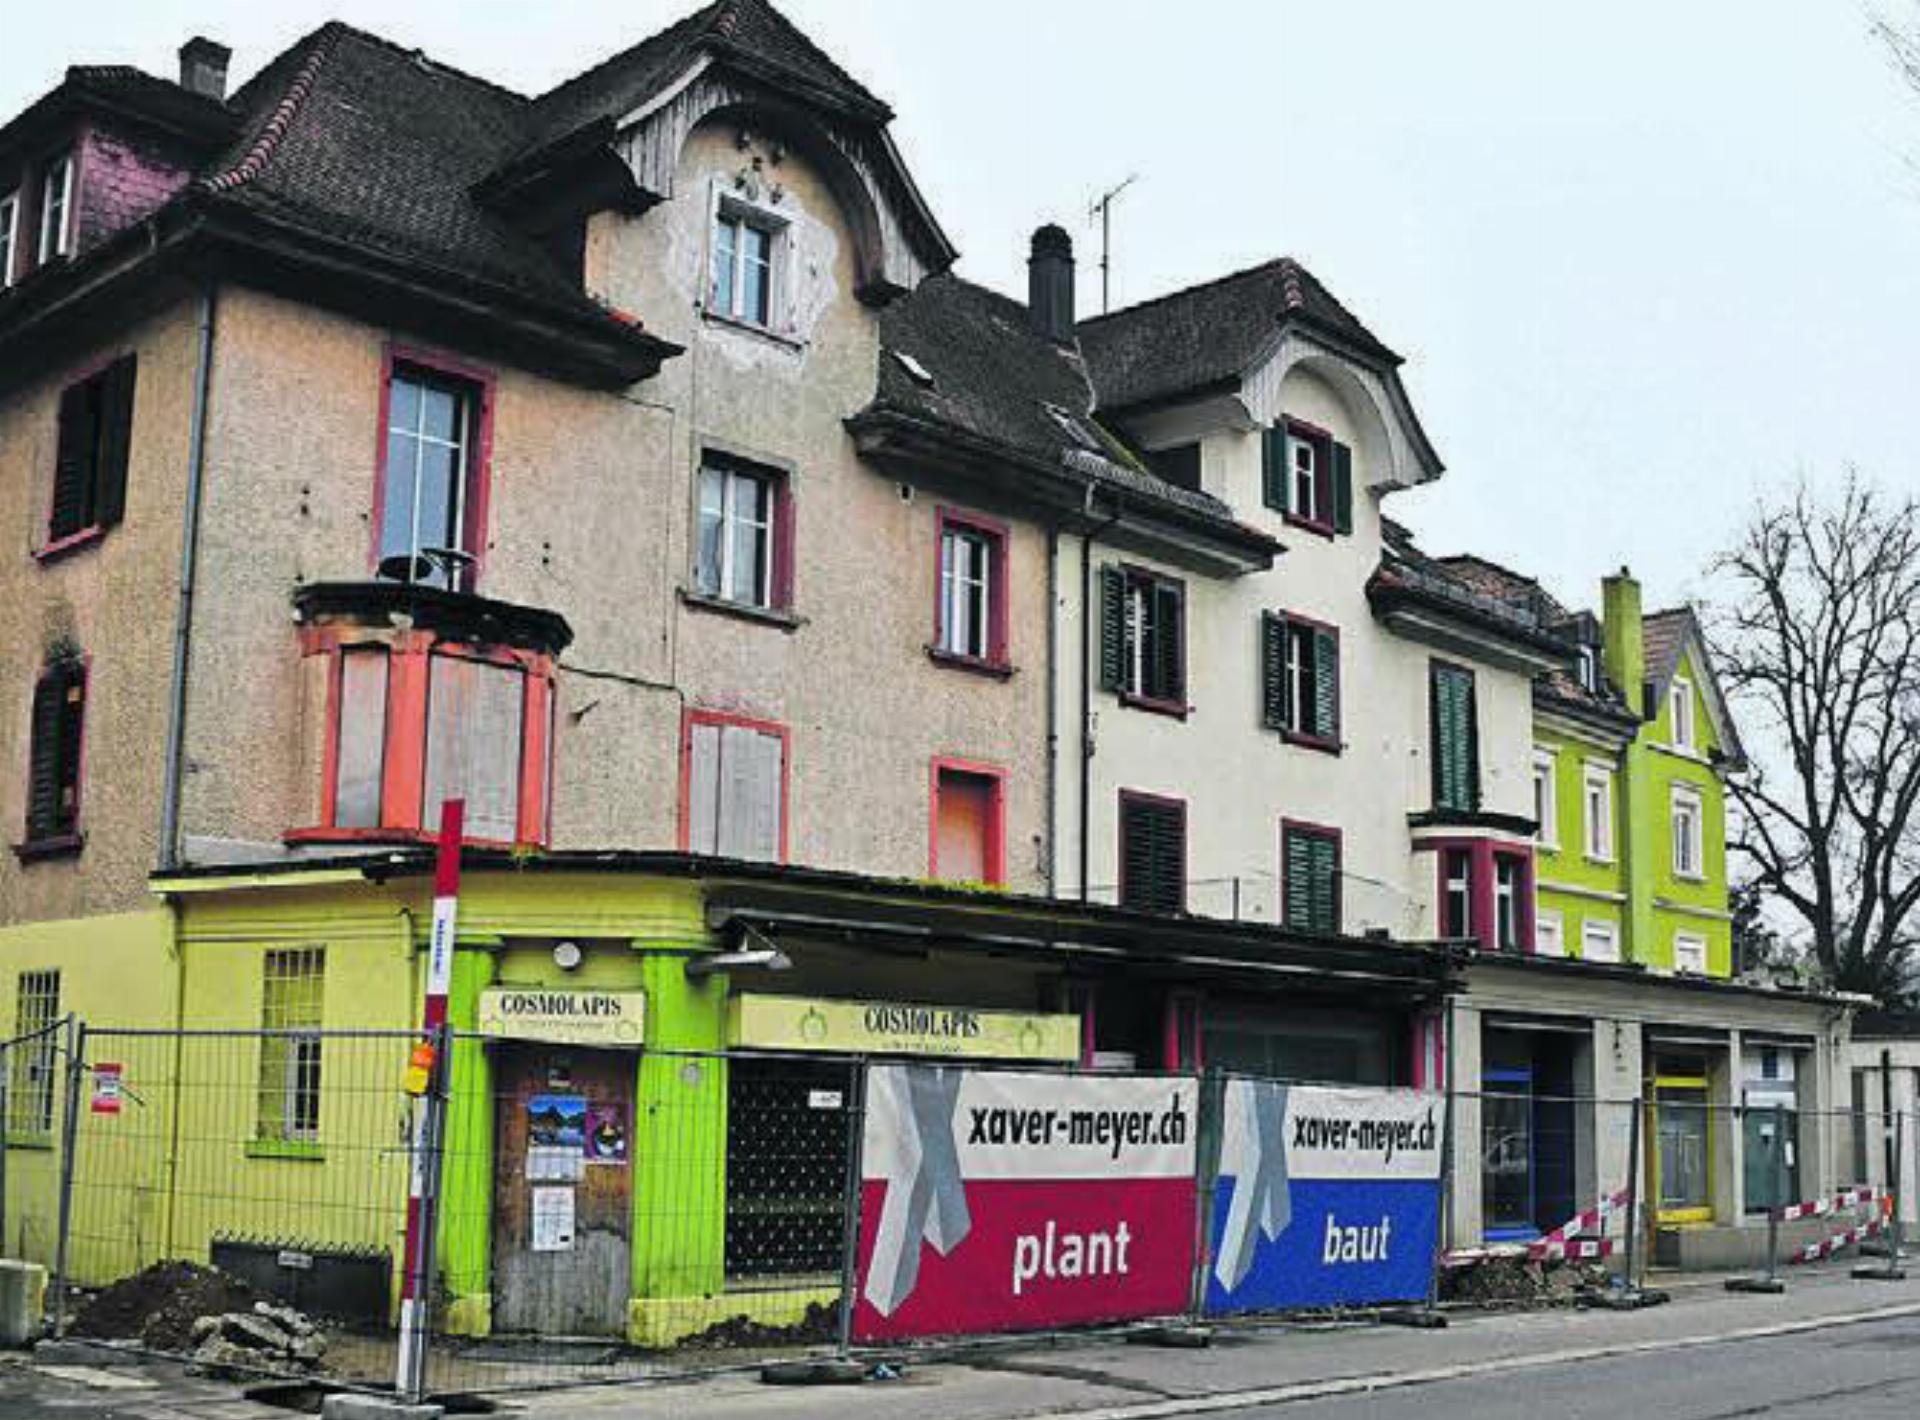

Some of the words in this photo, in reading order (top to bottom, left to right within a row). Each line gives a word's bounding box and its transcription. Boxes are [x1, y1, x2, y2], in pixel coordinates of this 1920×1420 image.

[500, 994, 622, 1016] COSMOLAPIS
[864, 1006, 981, 1038] COSMOLAPIS
[968, 1093, 1187, 1159] xaver-meyer.ch
[1292, 1106, 1436, 1164] xaver-meyer.ch
[1013, 1221, 1131, 1295] plant
[1322, 1214, 1391, 1266] baut
